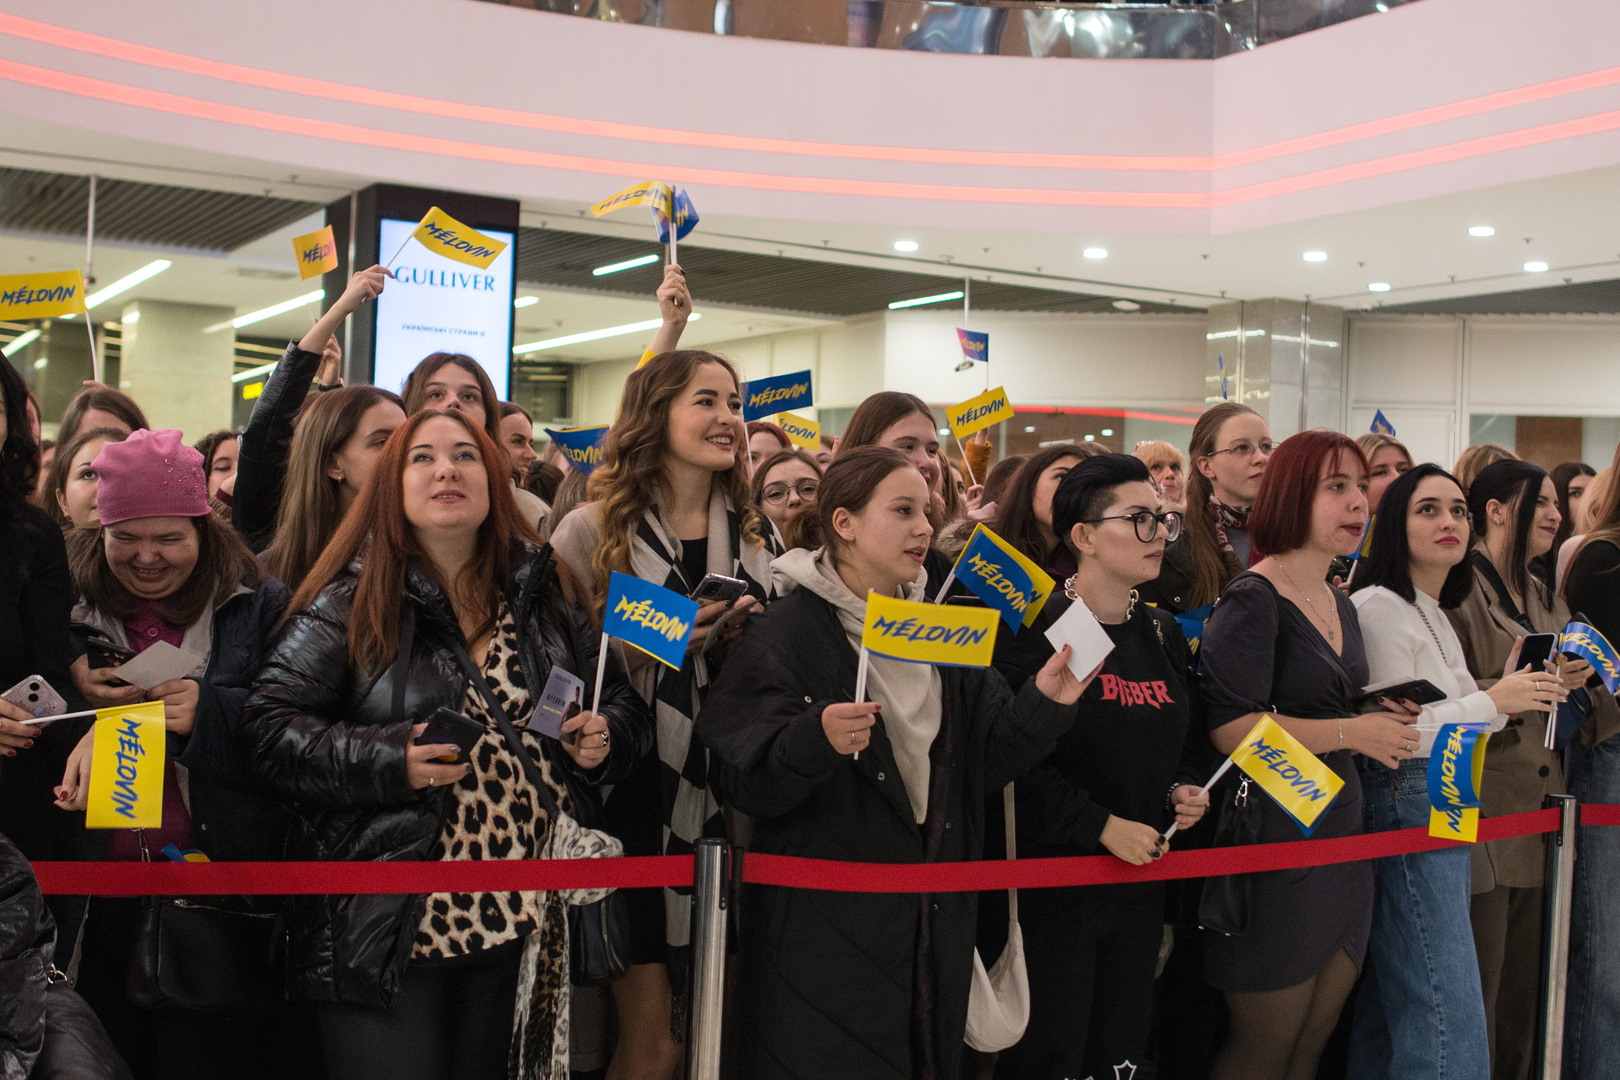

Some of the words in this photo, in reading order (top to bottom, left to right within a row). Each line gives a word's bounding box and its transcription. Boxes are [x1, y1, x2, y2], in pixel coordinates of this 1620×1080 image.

[424, 221, 496, 258] MÉLOVIN
[1, 284, 76, 307] MÉLOVIN
[394, 265, 495, 291] GULLIVER
[748, 381, 809, 409] MÉLOVIN
[956, 396, 1005, 427] MÉLOVIN
[968, 551, 1028, 613] MÉLOVIN
[614, 594, 690, 642] MÉLOVIN
[872, 614, 988, 648] MÉLOVIN
[1096, 673, 1176, 710] BIEBER
[110, 718, 146, 819] MÉLOVIN
[1249, 737, 1329, 802] MÉLOVIN
[1441, 725, 1468, 807] MÉLOVIN
